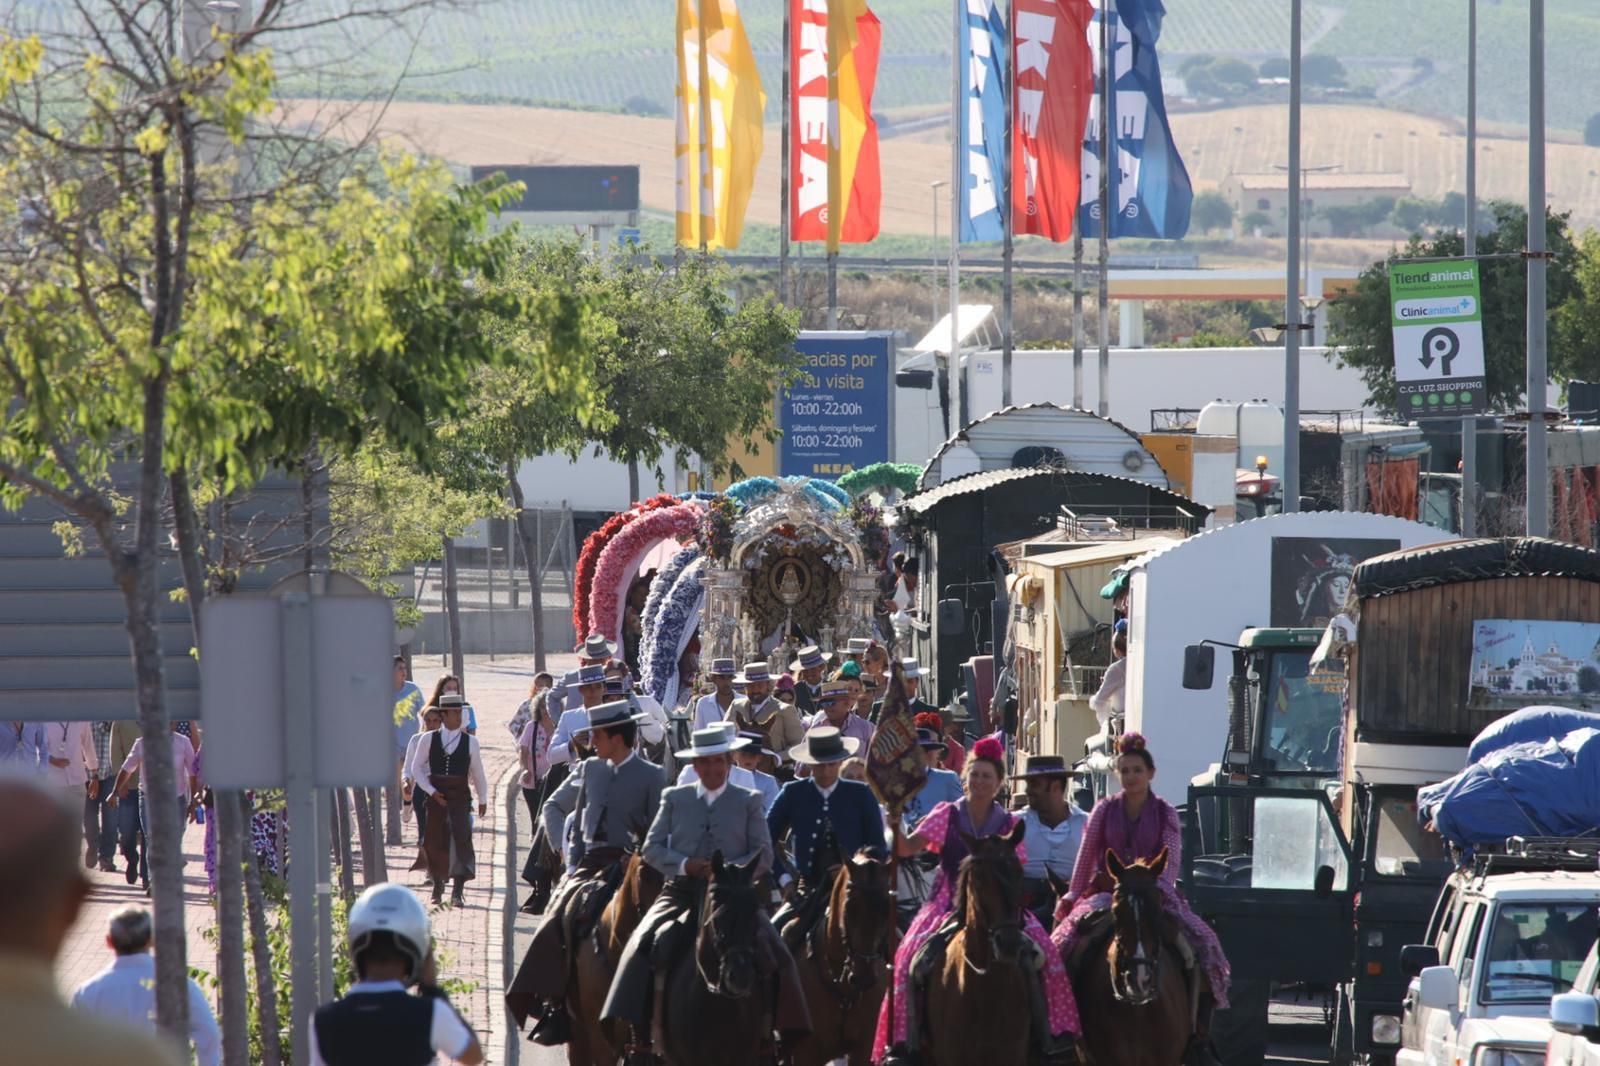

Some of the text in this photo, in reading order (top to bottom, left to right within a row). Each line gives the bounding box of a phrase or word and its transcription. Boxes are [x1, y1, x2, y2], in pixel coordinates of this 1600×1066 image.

[1393, 268, 1474, 284] Tiendanimal
[1400, 305, 1460, 318] Clinicanimal
[851, 354, 877, 370] por
[803, 374, 865, 389] su visita
[1399, 381, 1482, 394] C.C. LUZ SHOPPING
[791, 403, 819, 415] 10:00
[791, 436, 819, 448] 10:00
[813, 463, 852, 474] IKEA
